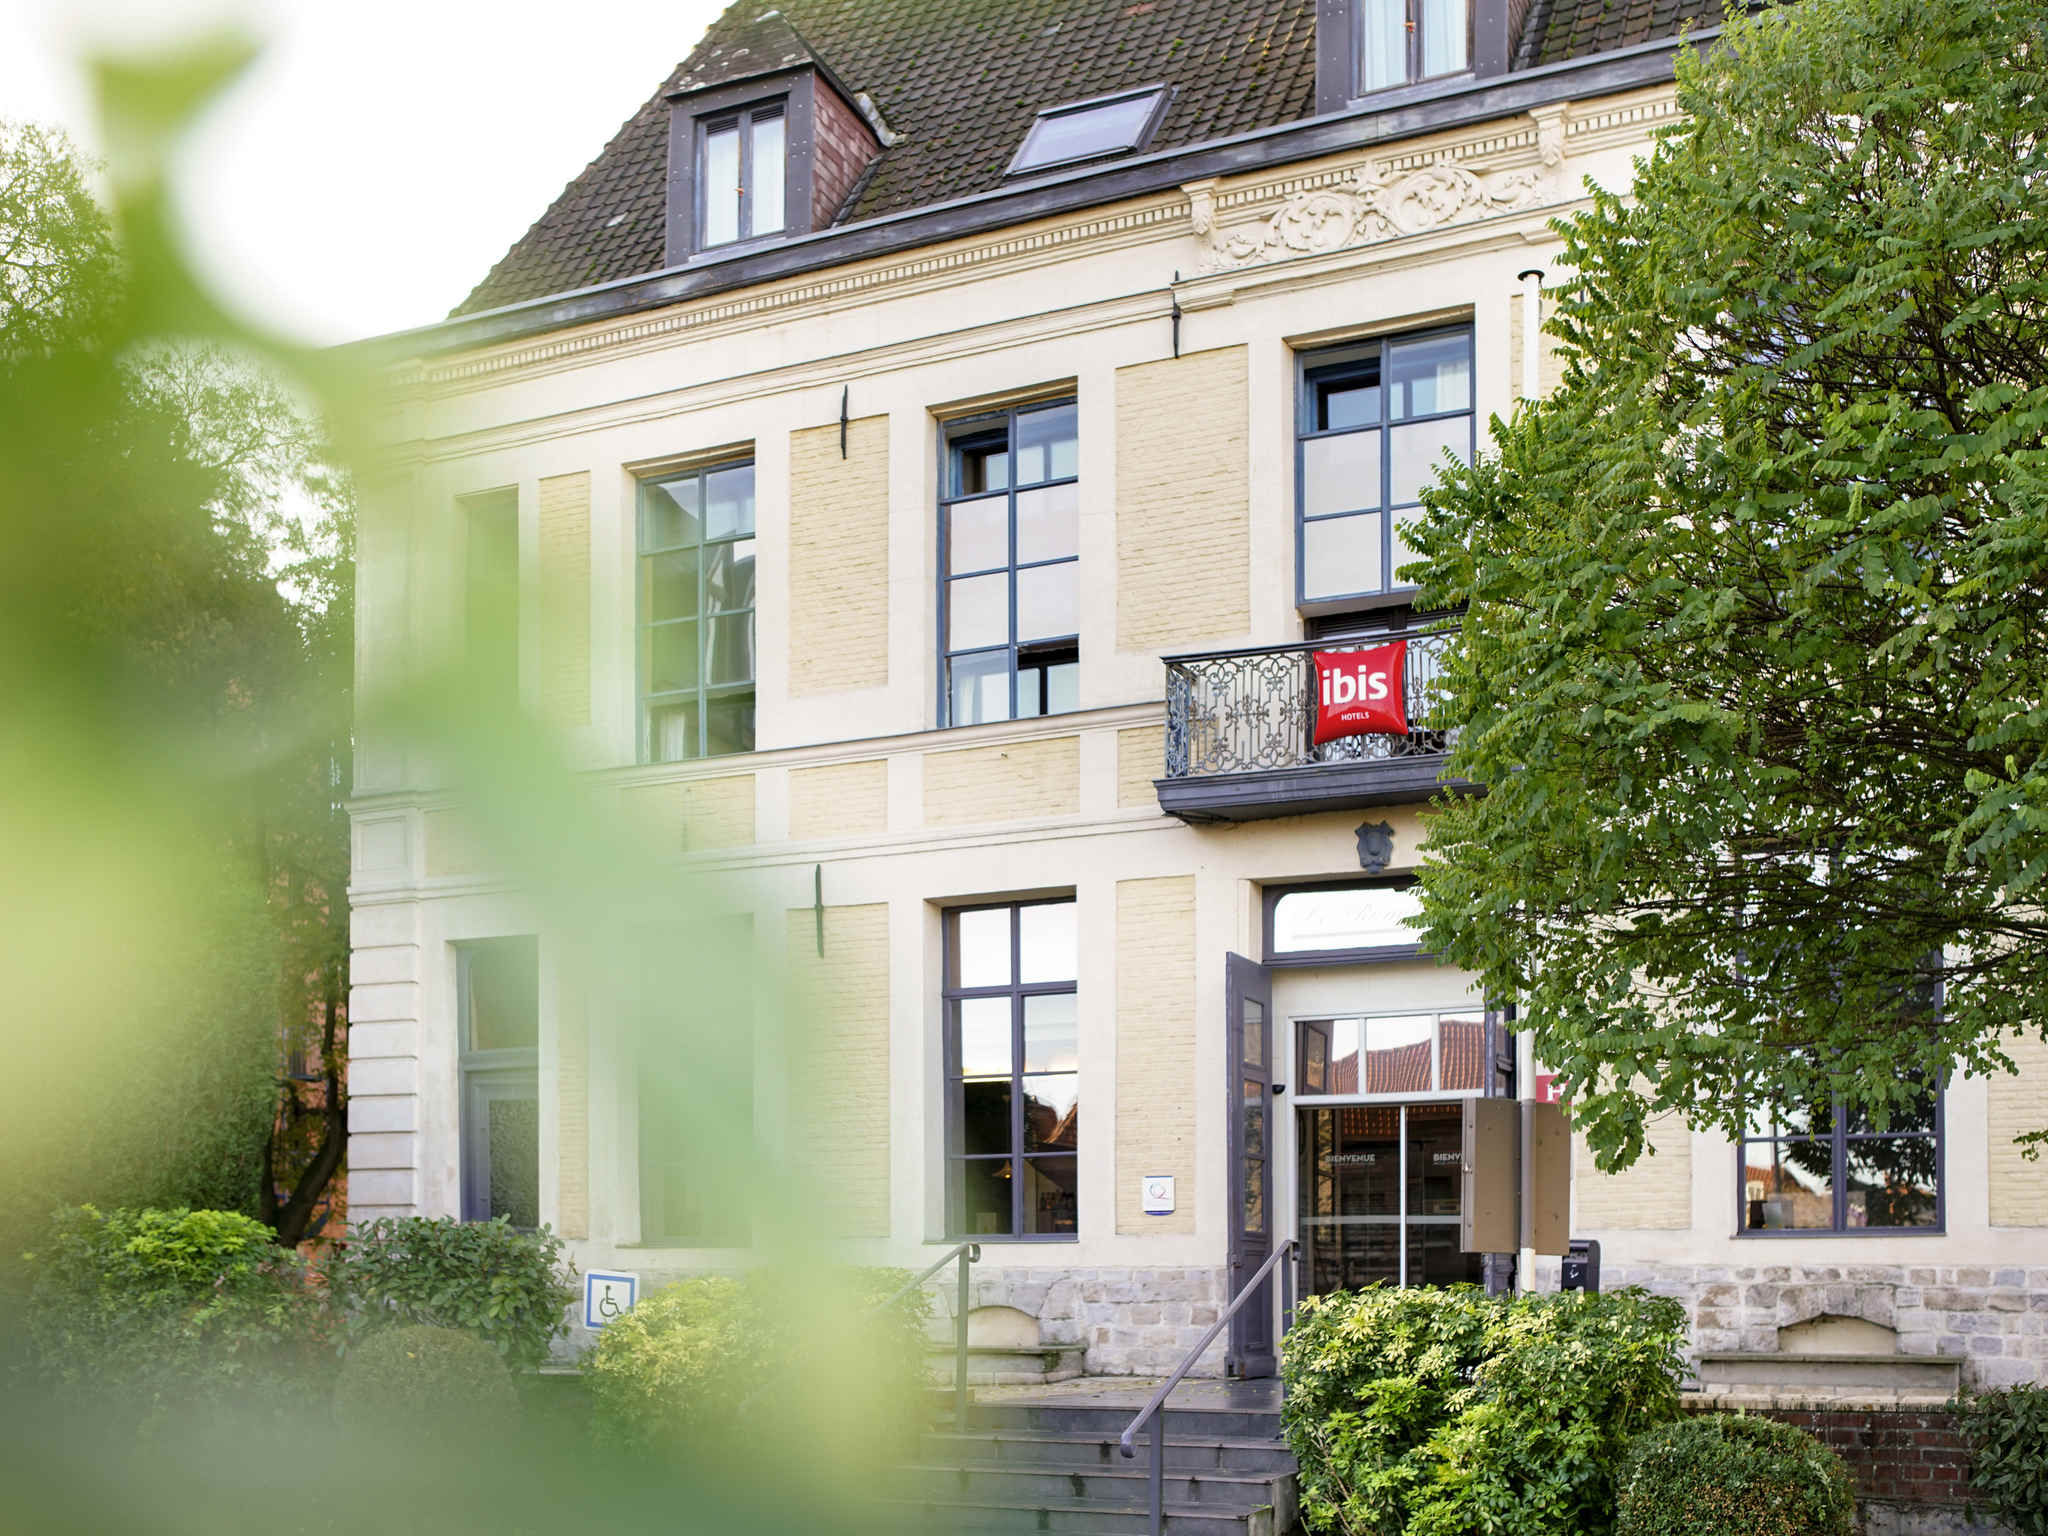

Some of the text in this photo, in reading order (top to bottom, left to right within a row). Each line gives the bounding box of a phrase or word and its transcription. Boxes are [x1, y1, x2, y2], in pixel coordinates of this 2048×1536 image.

[1322, 664, 1388, 706] ibis
[1341, 711, 1370, 720] HOTELS
[1325, 1153, 1376, 1163] BIENVENUE
[1433, 1152, 1463, 1161] BIENV
